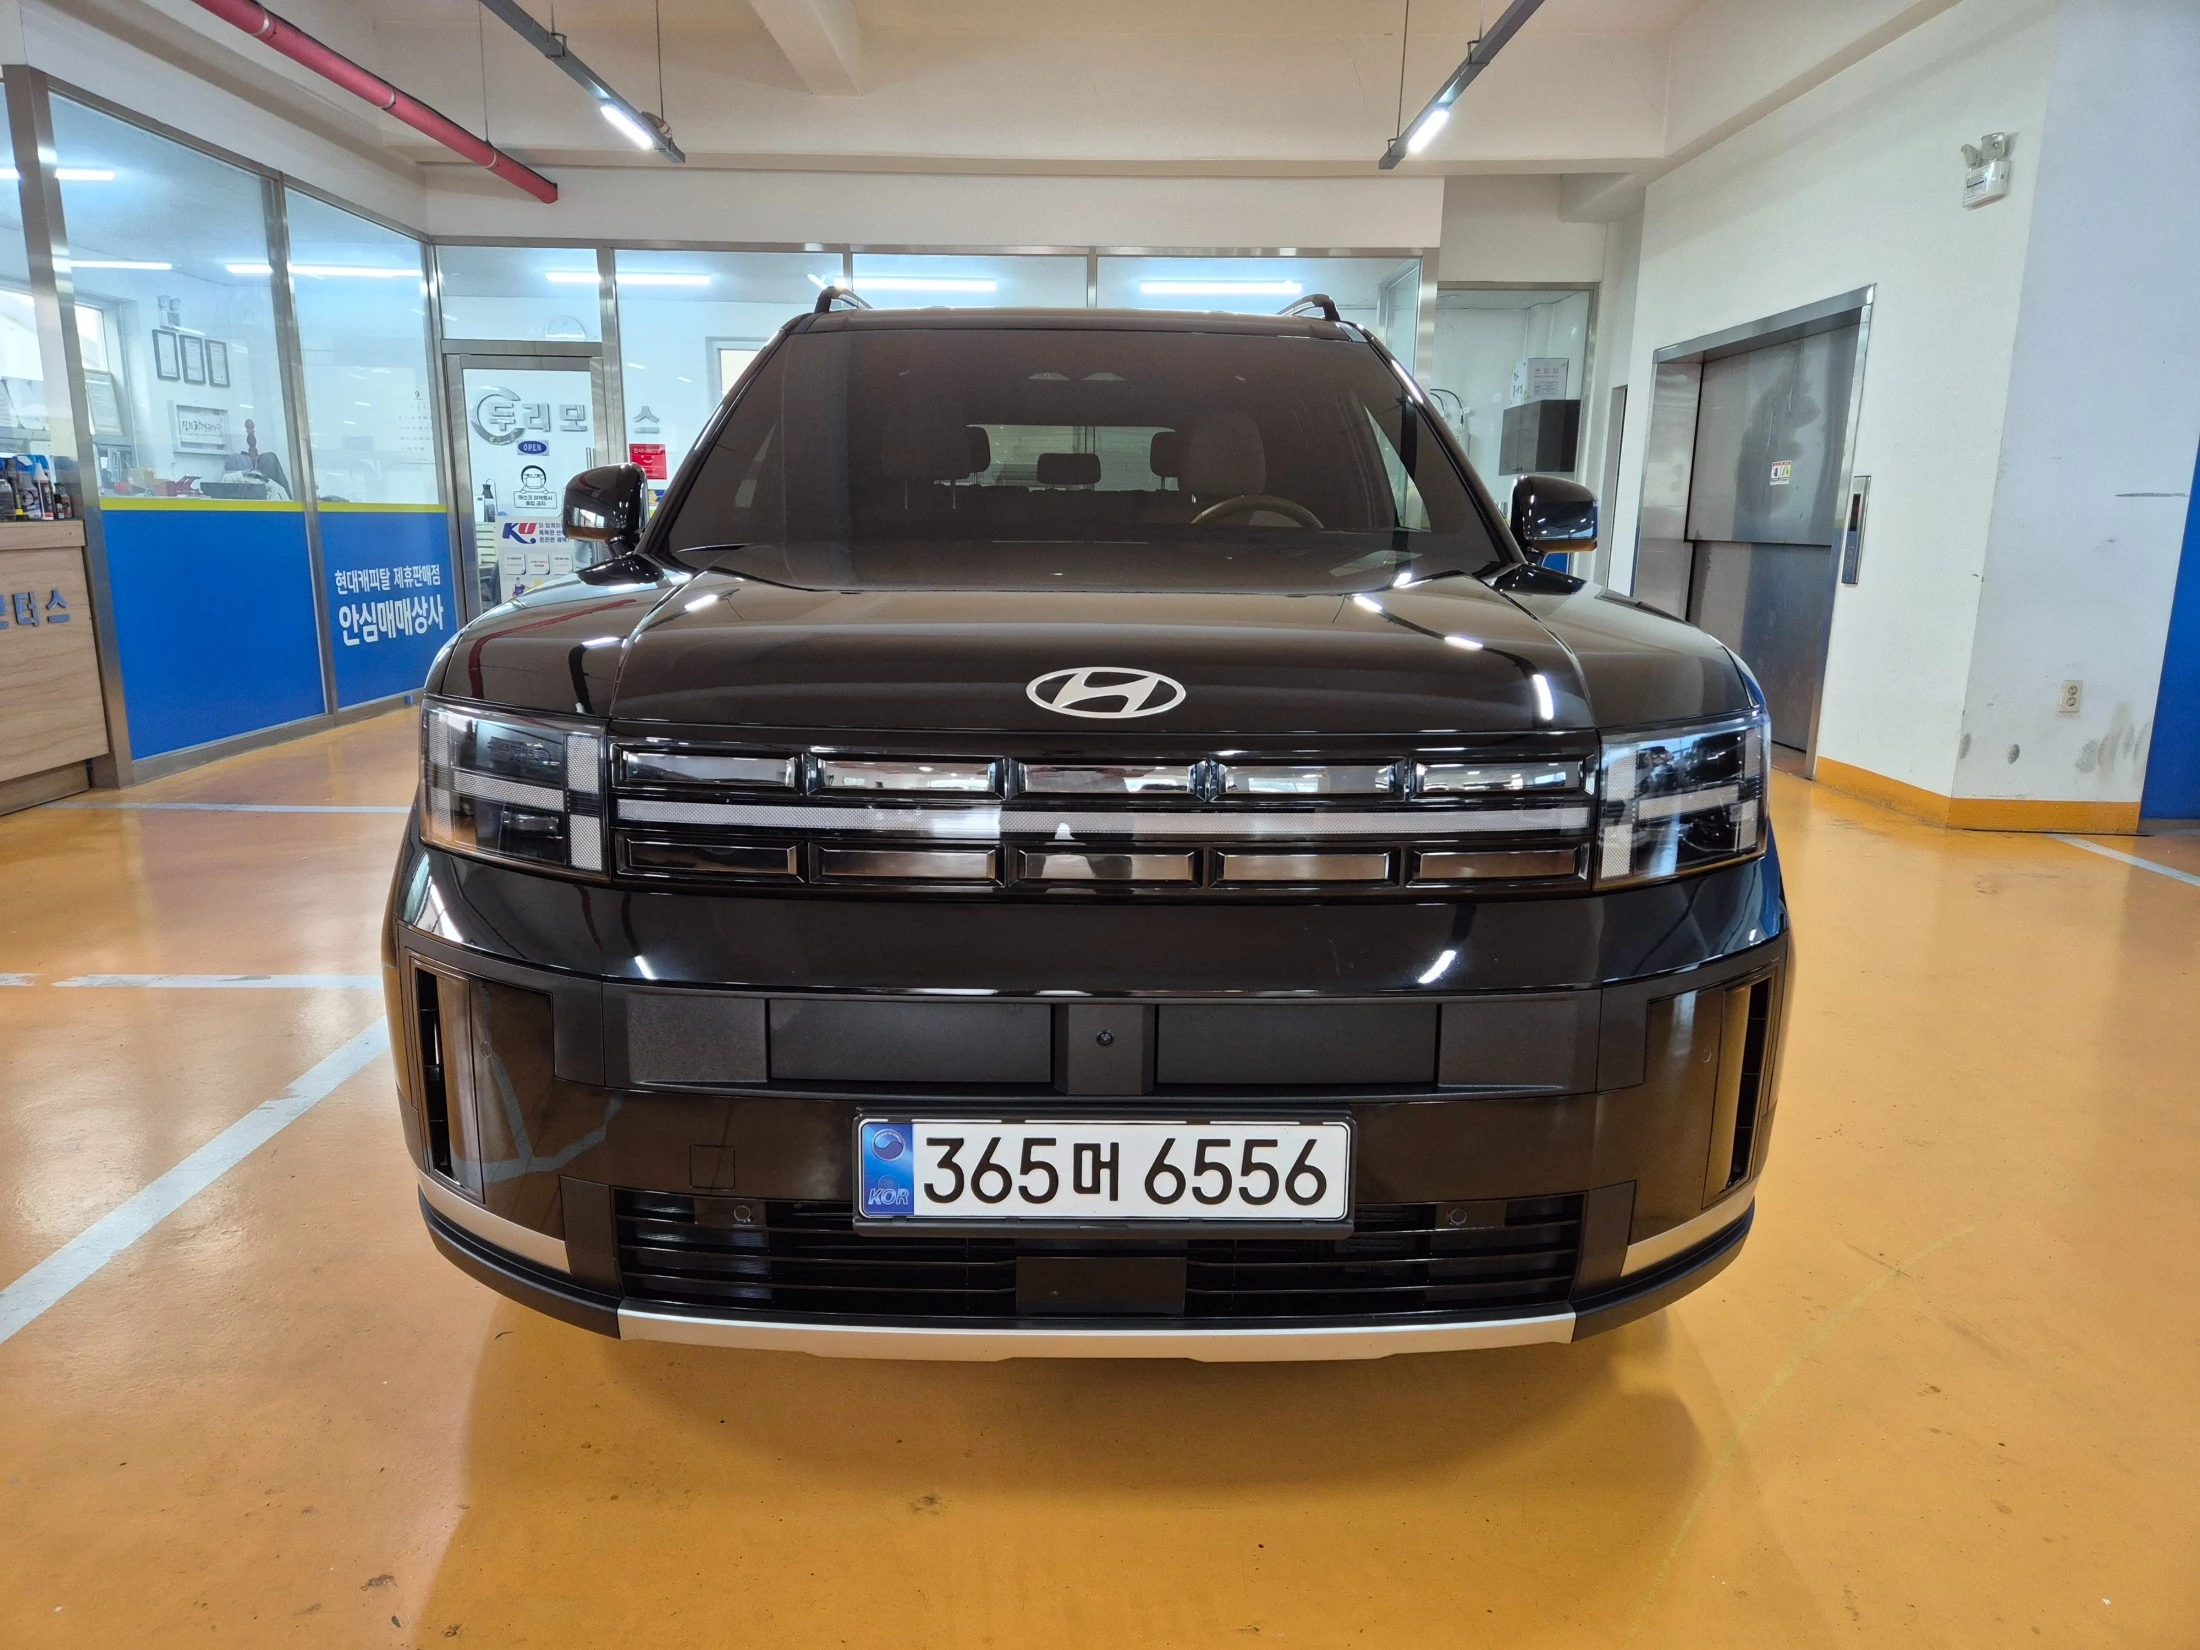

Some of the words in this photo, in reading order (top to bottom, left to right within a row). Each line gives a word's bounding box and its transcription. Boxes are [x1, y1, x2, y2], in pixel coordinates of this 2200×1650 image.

[414, 390, 420, 398] 9
[487, 403, 661, 434] 두리모스
[522, 443, 542, 452] OPEN
[334, 567, 391, 595] 현대캐피탈
[393, 564, 441, 589] 제휴판매점
[338, 594, 444, 647] 안심매매상사
[923, 1136, 1120, 1204] 365머
[1143, 1137, 1328, 1206] 6556
[867, 1187, 910, 1206] KOR
